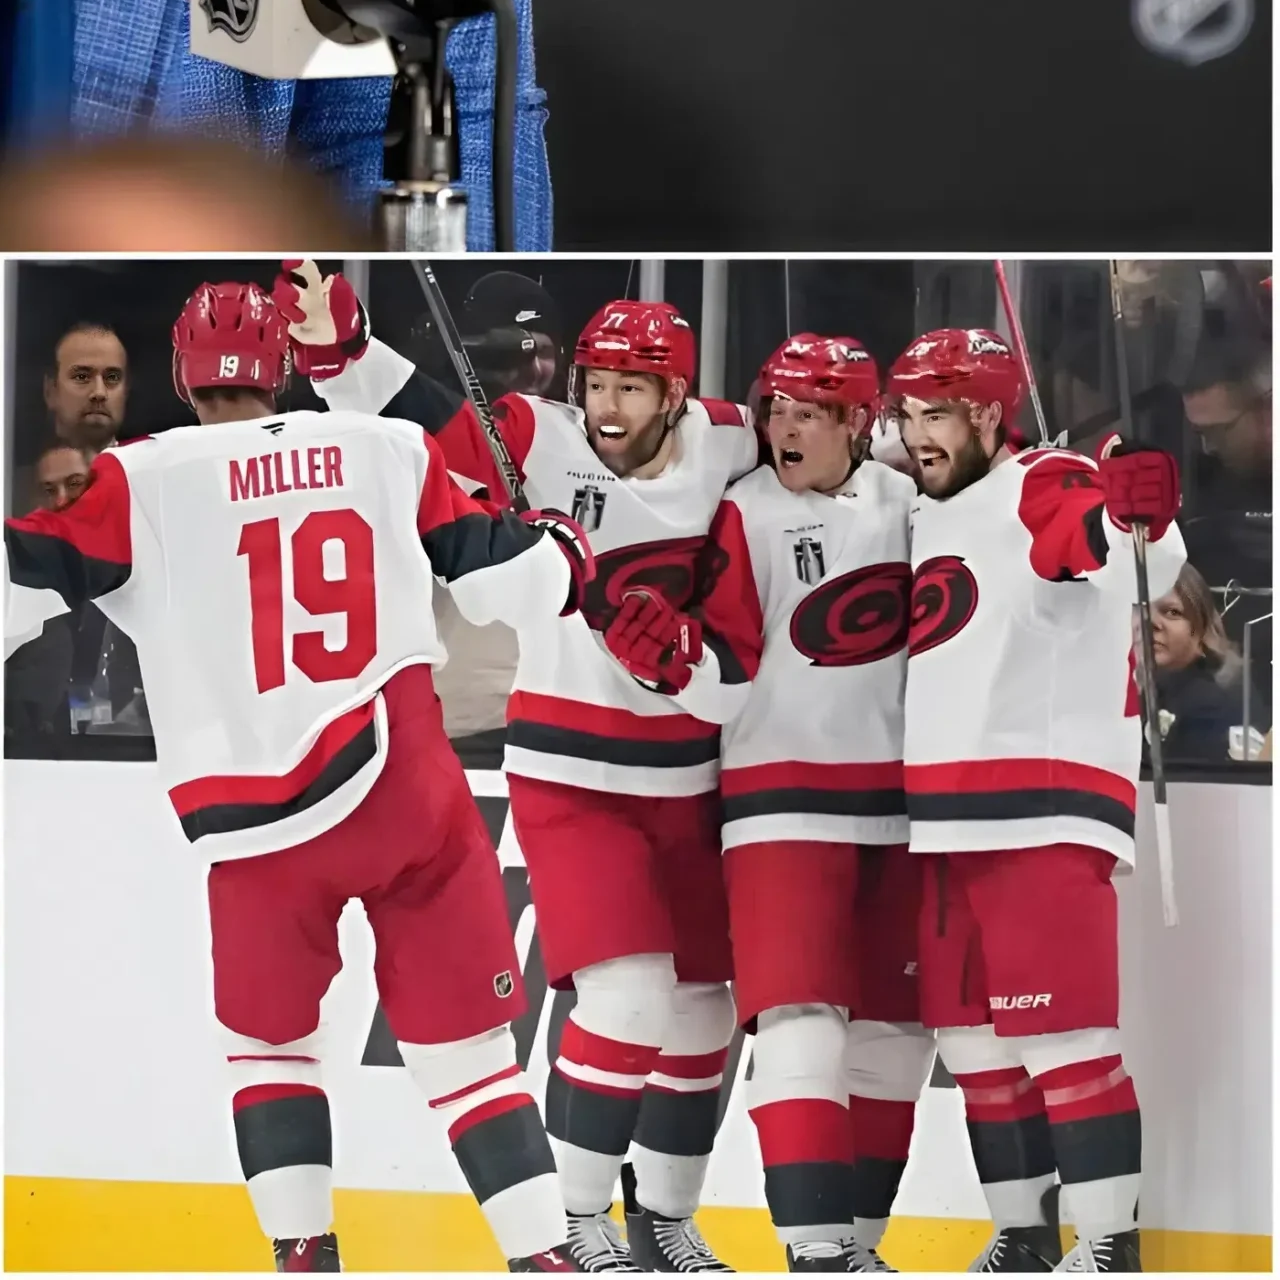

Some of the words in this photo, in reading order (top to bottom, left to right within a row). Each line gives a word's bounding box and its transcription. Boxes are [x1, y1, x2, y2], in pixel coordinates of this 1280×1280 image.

[219, 355, 239, 378] 19
[228, 445, 344, 502] MILLER
[235, 507, 378, 695] 19
